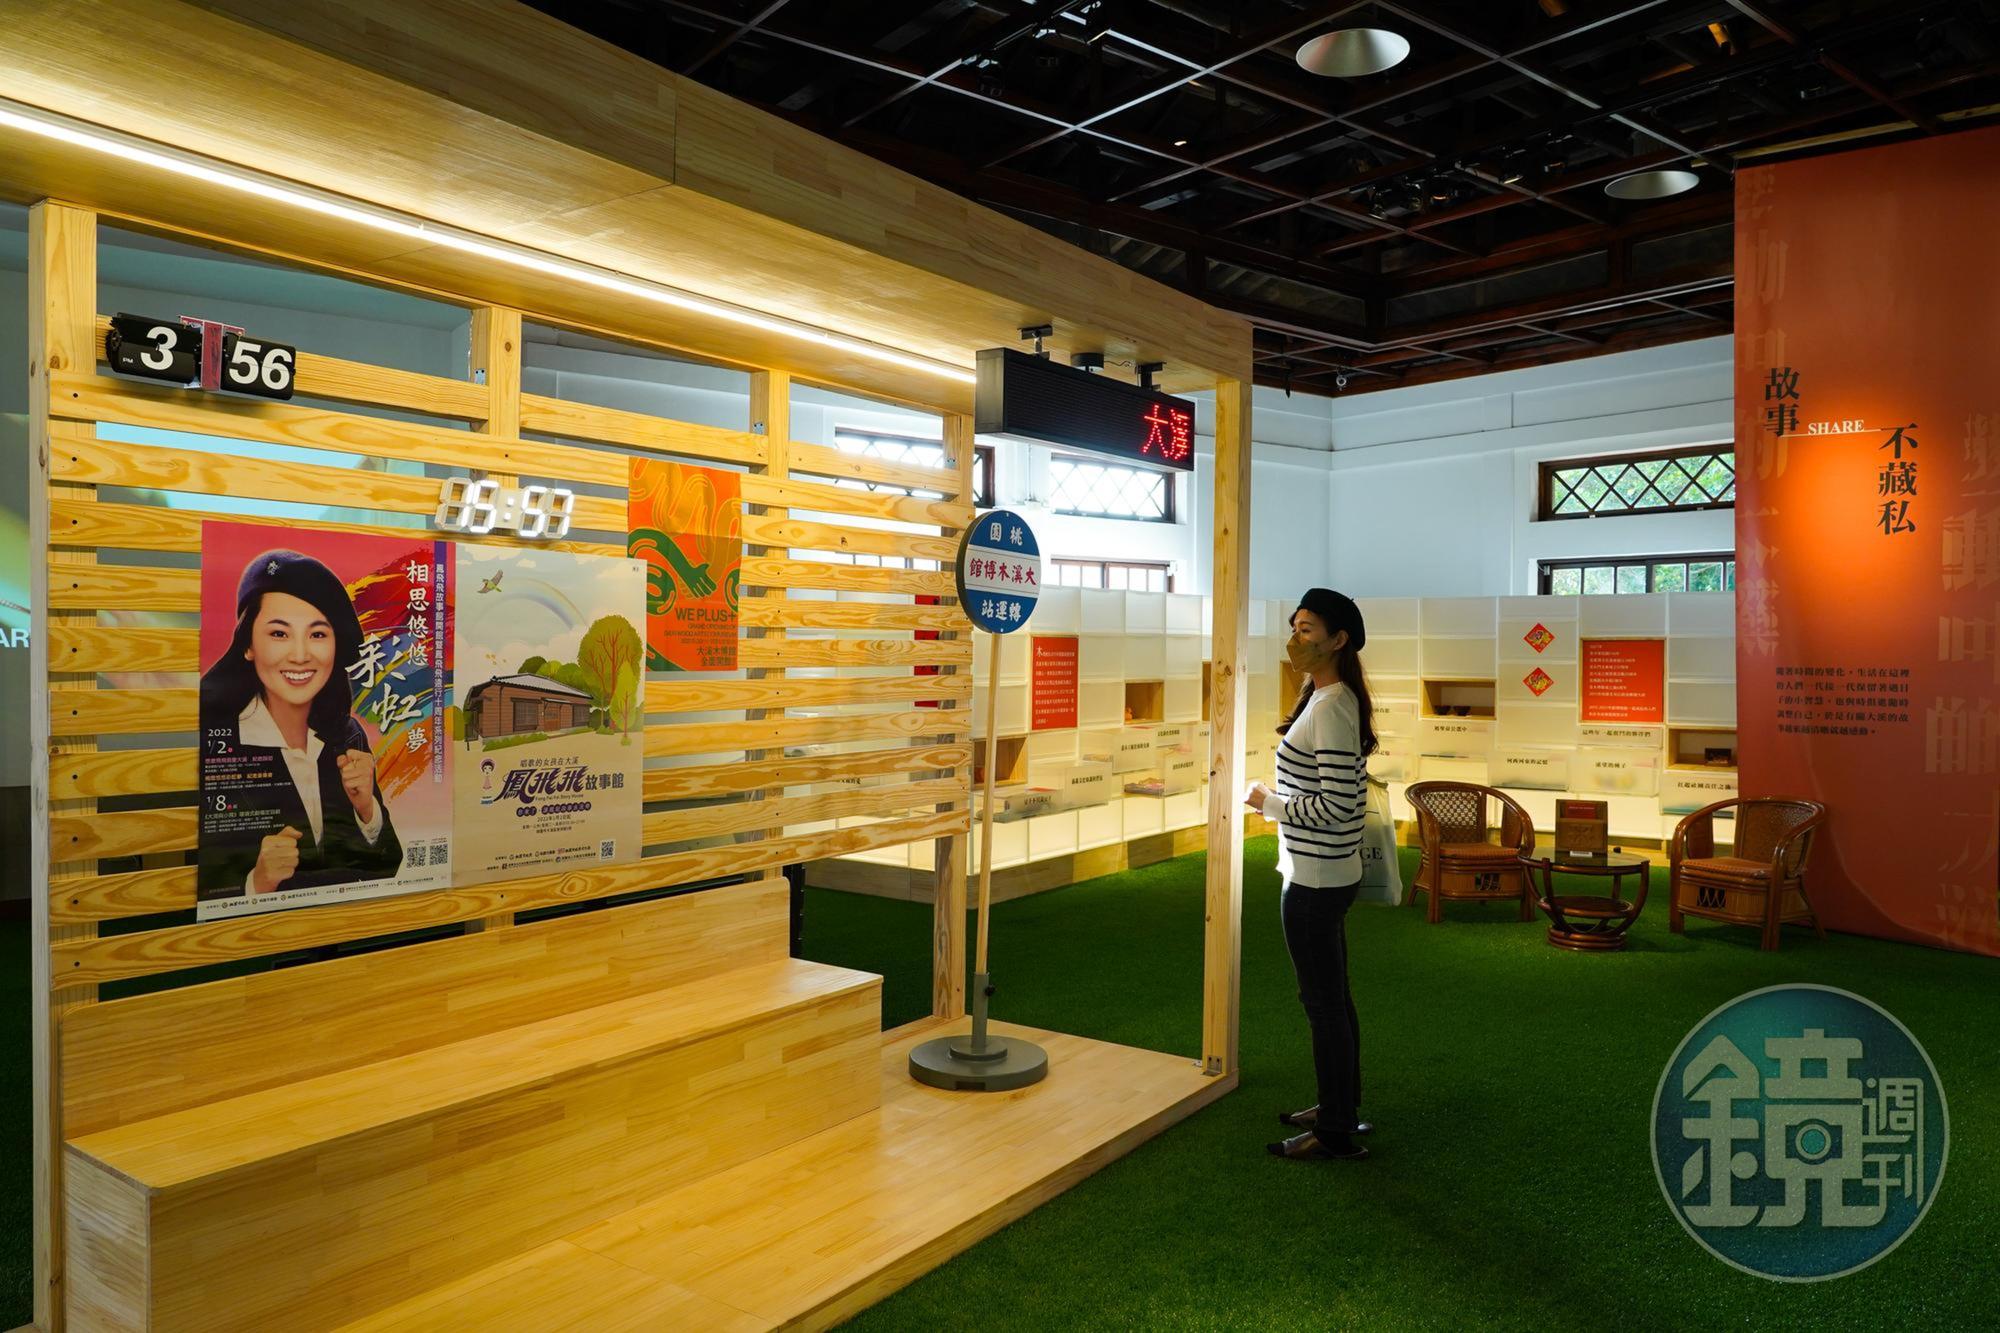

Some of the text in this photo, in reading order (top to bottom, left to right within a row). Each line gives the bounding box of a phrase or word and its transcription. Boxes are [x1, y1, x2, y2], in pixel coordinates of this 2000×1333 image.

[140, 326, 178, 370] 3
[229, 341, 293, 390] 56
[1763, 367, 1800, 437] 故事
[1808, 420, 1865, 435] SHARE
[1876, 423, 1919, 535] 不藏私
[989, 522, 1023, 546] 桃園
[969, 558, 1037, 585] 大溪木博館
[406, 560, 430, 667] 相思悠悠
[675, 607, 737, 623] WE PLUS+
[981, 600, 1022, 622] 轉運站
[208, 728, 232, 737] 2022
[406, 727, 428, 754] 夢
